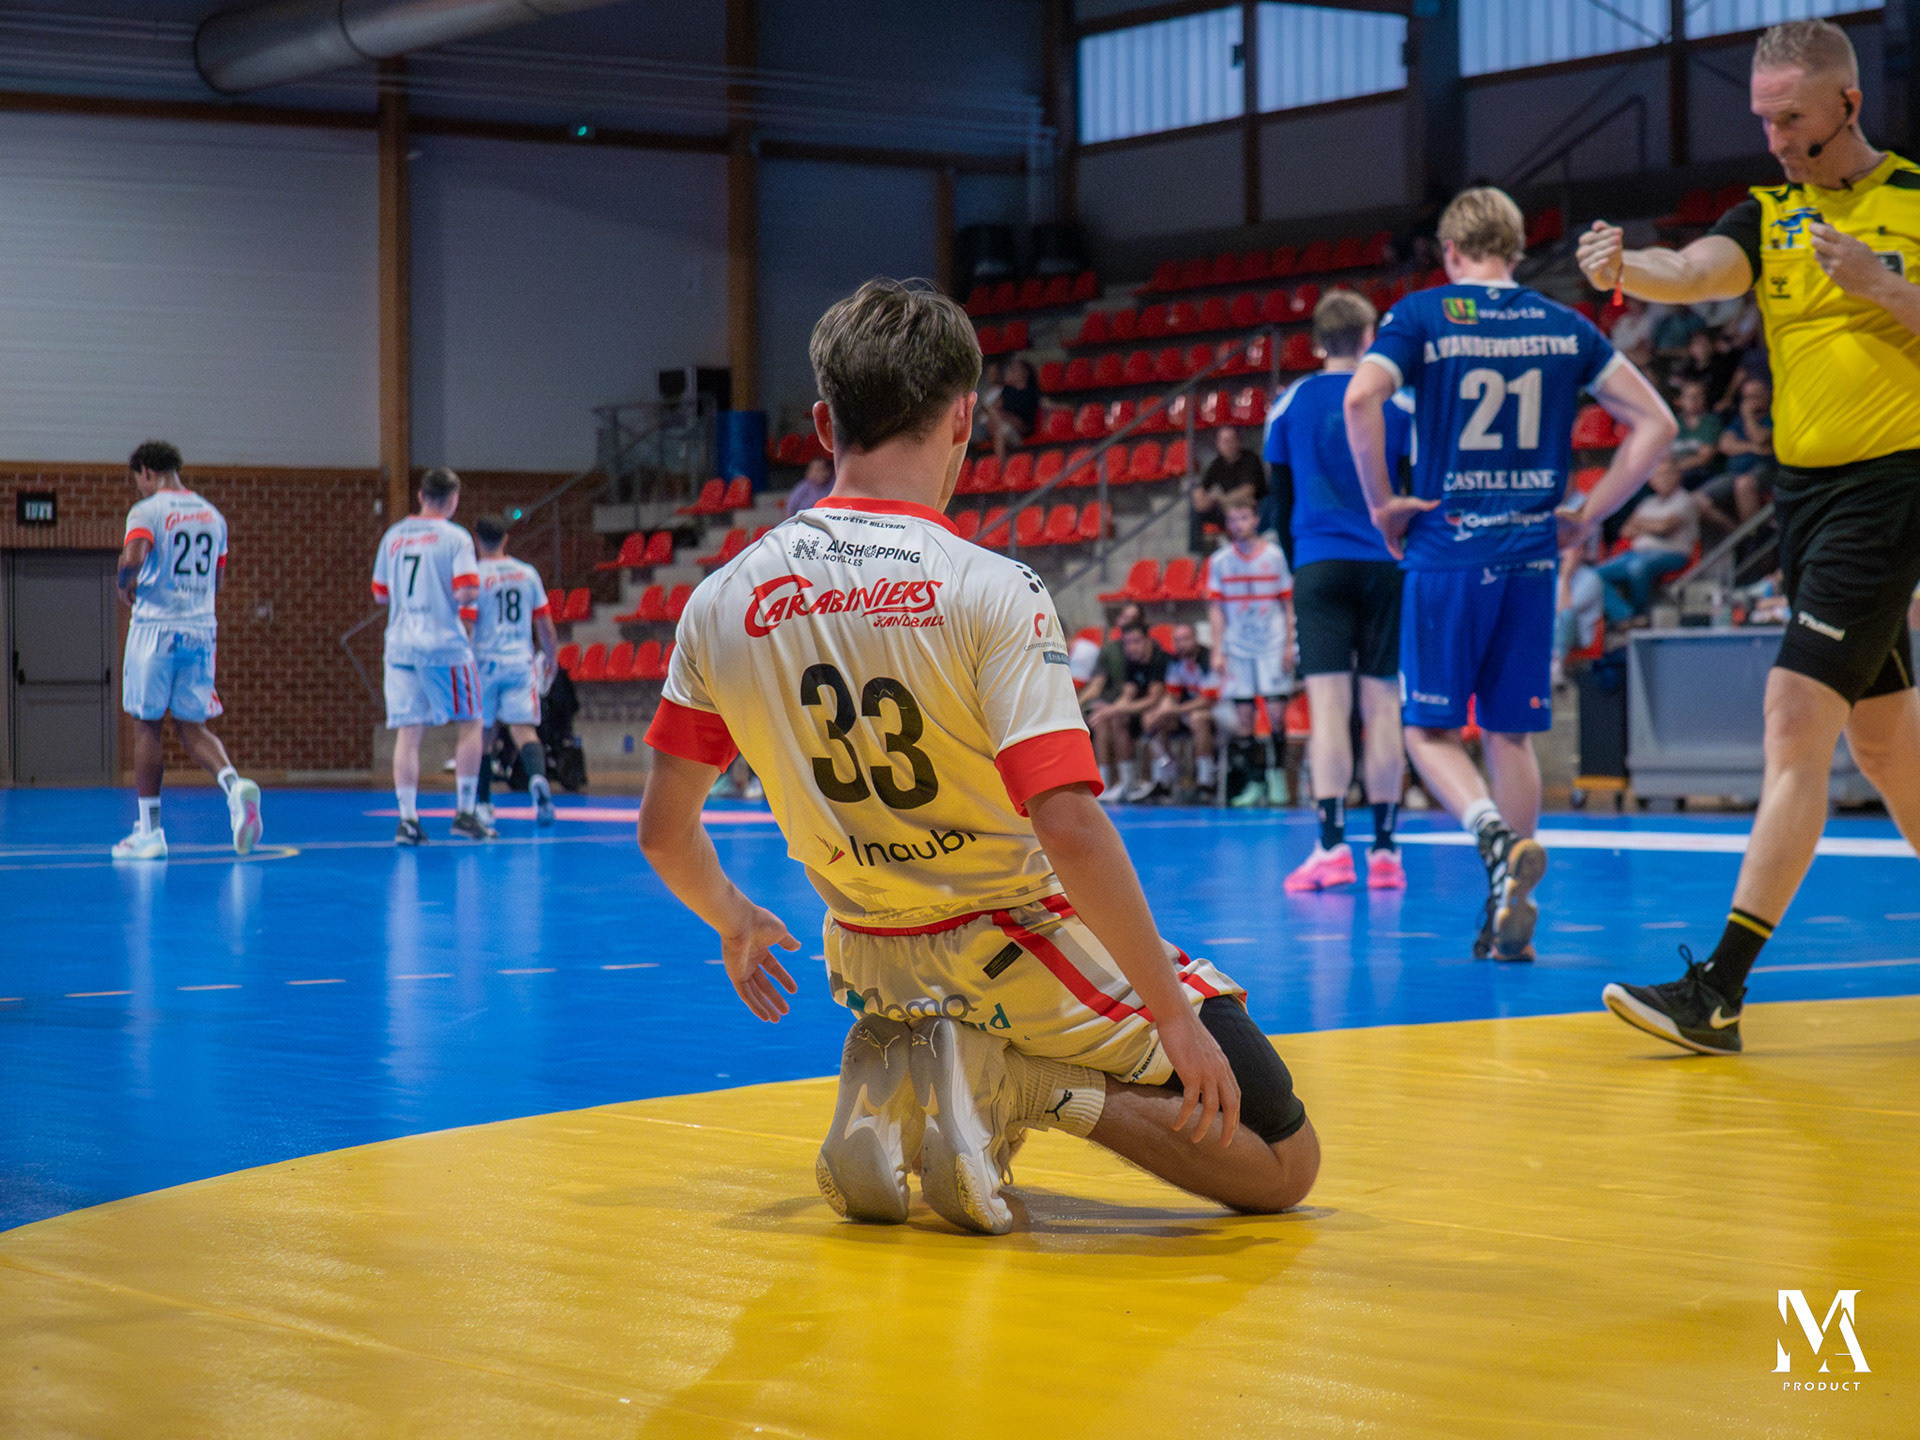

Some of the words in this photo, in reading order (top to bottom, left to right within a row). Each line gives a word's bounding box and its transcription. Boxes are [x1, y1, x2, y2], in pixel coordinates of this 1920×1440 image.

[1458, 367, 1542, 451] 21
[1443, 470, 1508, 491] CASTLE
[1511, 469, 1556, 489] LINE
[174, 531, 213, 576] 23
[404, 555, 420, 598] 7
[496, 589, 520, 623] 18
[744, 574, 944, 638] CARABINIERS
[873, 613, 945, 628] HANDBALL
[801, 663, 938, 809] 33
